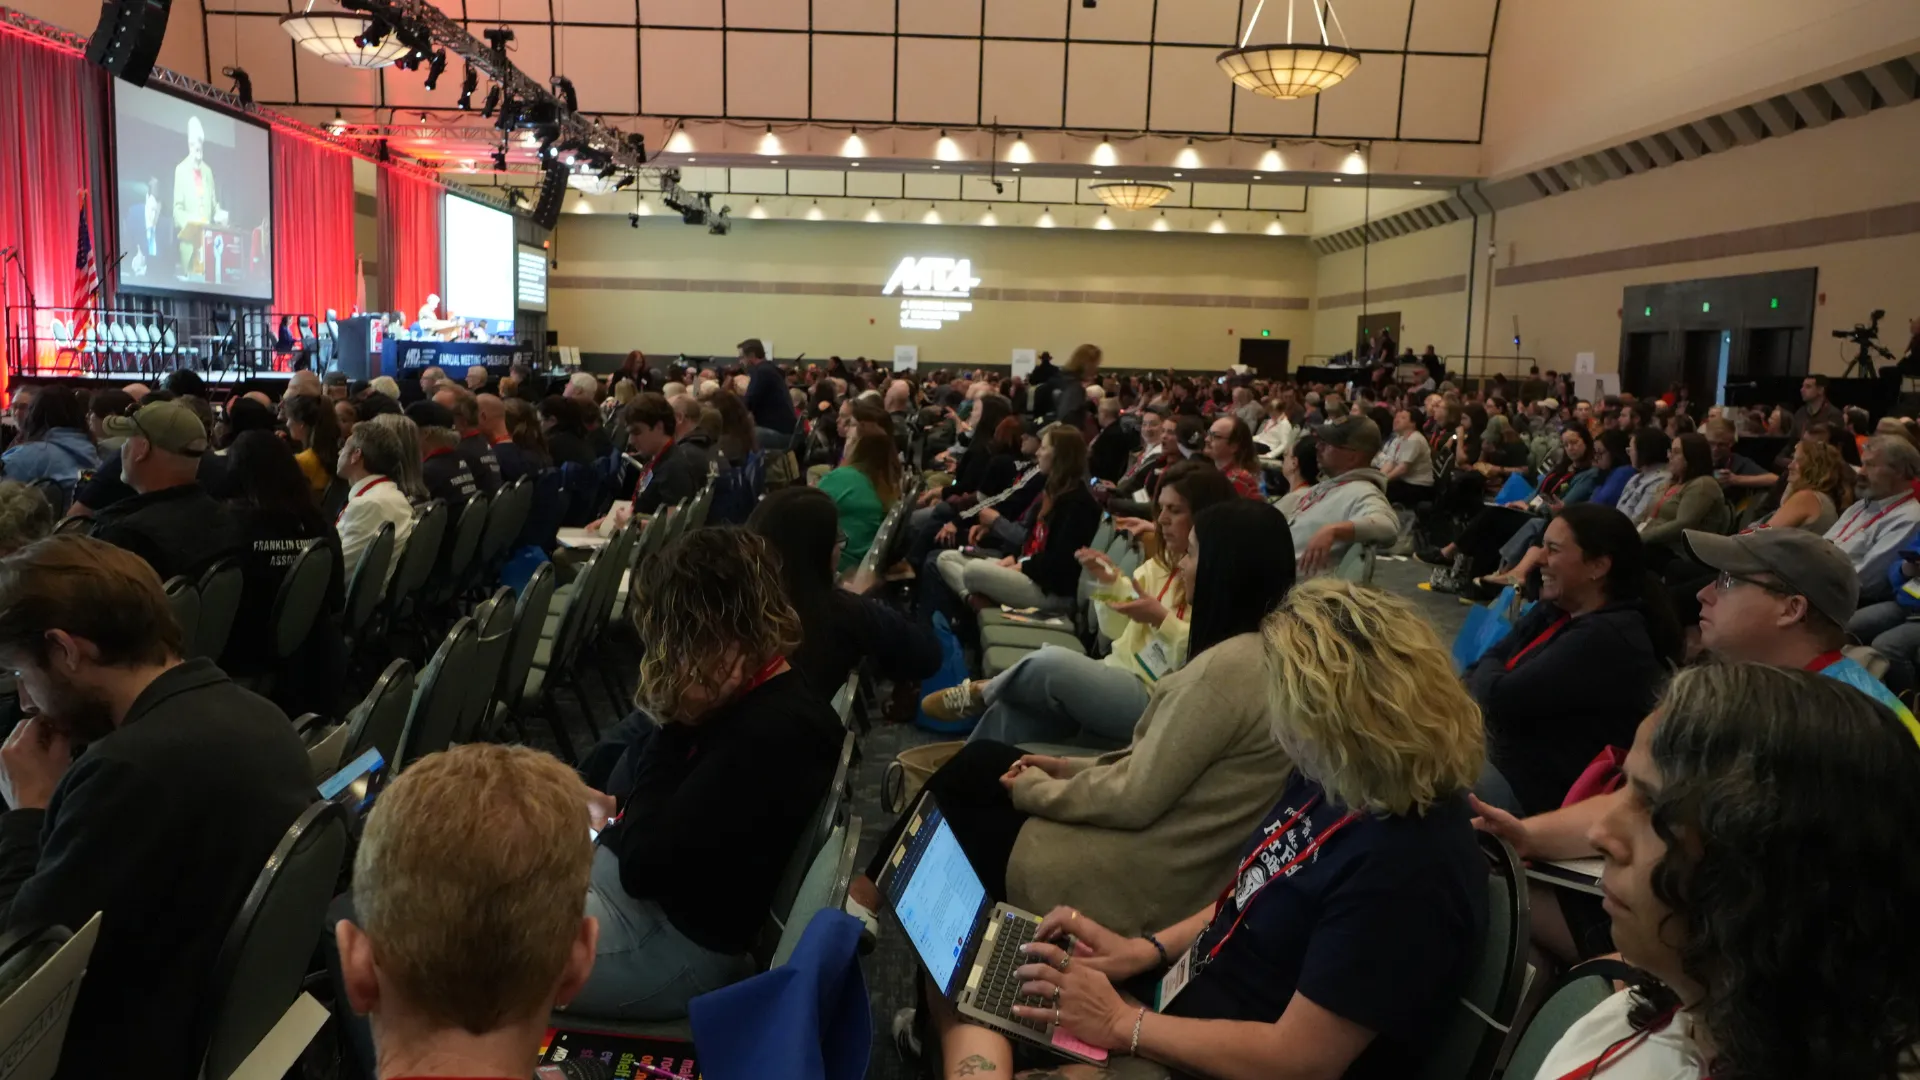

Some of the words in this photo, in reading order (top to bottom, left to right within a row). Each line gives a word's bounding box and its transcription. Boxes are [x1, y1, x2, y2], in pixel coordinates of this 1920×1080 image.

[882, 256, 980, 295] MTA
[461, 354, 481, 366] MEETING
[253, 540, 295, 551] FRANKLIN
[615, 1053, 634, 1077] shelf
